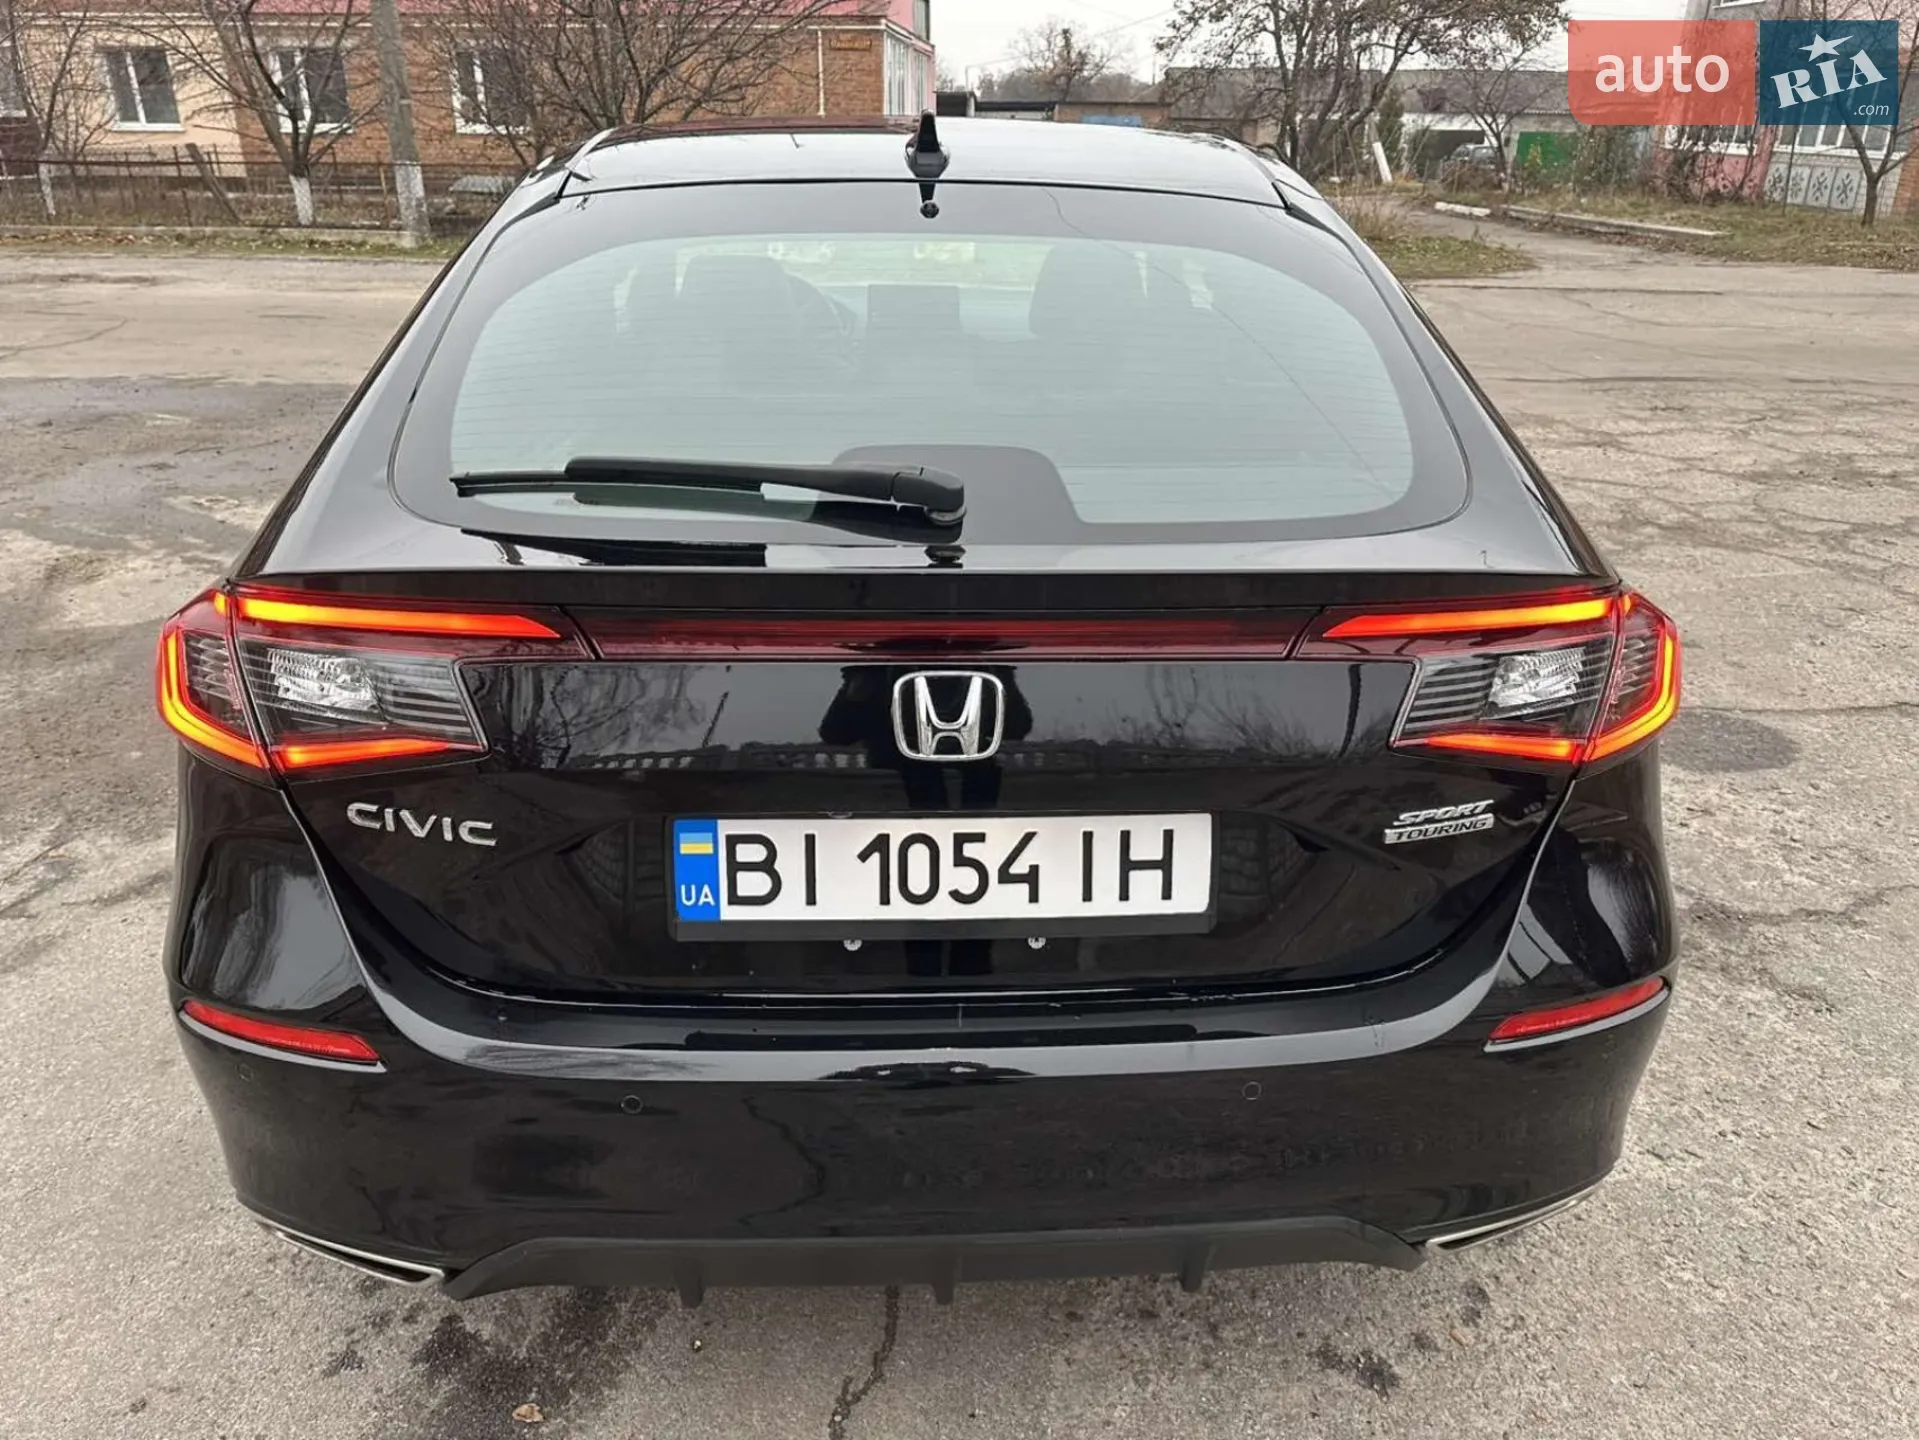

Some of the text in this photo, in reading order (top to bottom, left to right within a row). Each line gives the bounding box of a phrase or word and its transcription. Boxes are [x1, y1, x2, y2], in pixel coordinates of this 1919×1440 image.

[346, 801, 498, 847] CIVIC
[1393, 799, 1494, 826] SPORT
[1393, 818, 1489, 842] TOURING
[725, 828, 1174, 906] BI 1054 IH
[680, 884, 715, 907] UA
